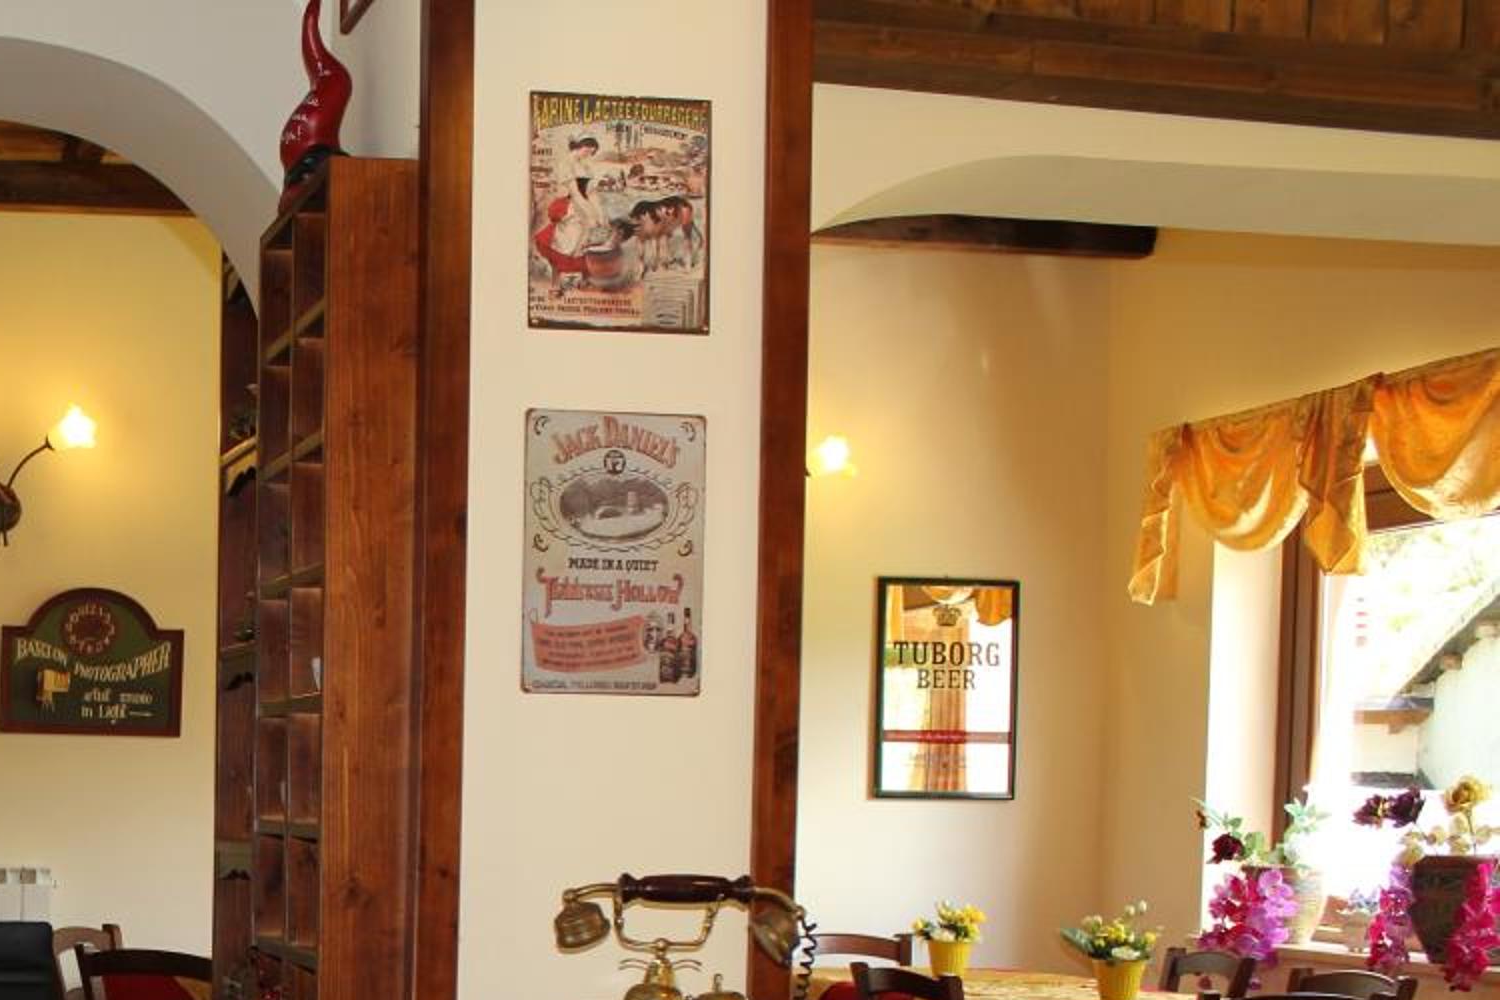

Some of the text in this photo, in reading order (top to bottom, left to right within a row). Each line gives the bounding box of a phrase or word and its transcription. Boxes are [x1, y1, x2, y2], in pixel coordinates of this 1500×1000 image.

[552, 424, 599, 463] JACK
[568, 558, 659, 572] MADE IN A QUIET
[893, 640, 1000, 667] TUBORG
[916, 668, 976, 689] BEER
